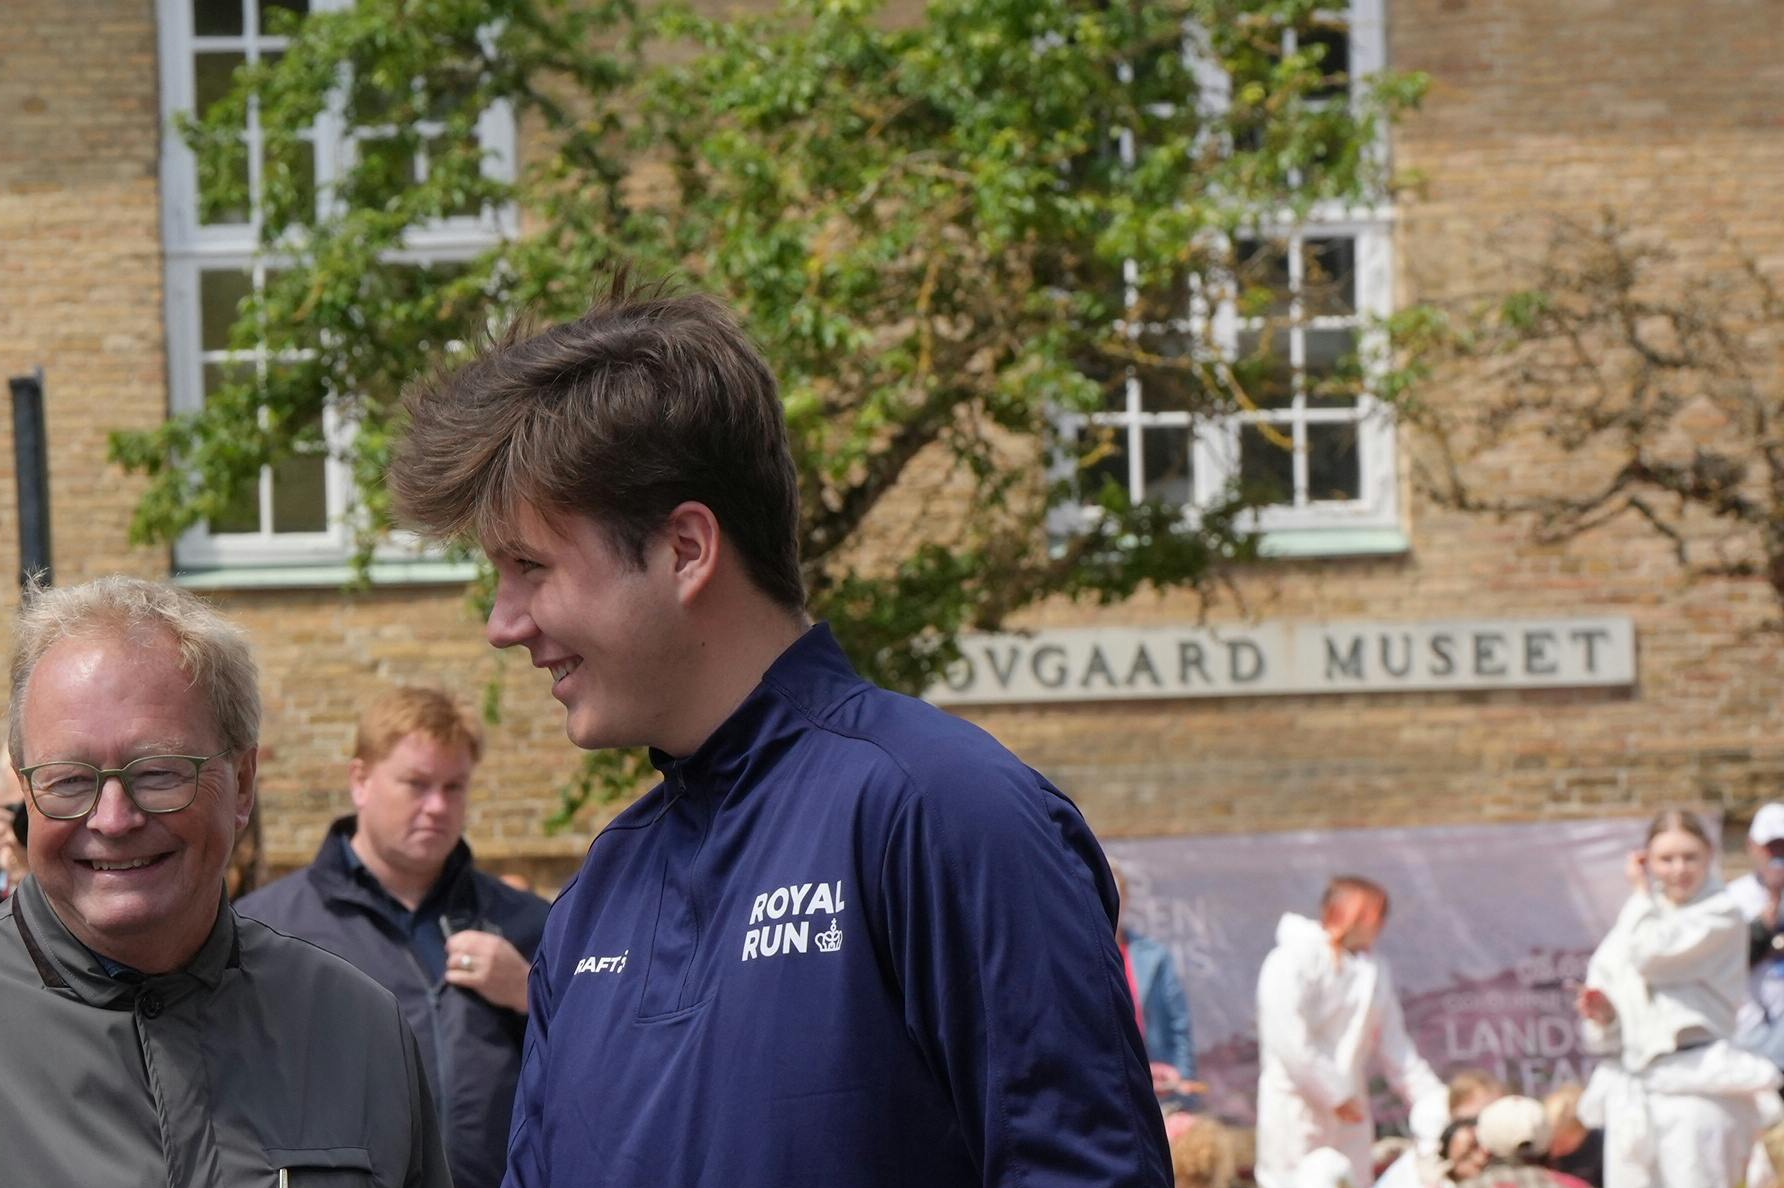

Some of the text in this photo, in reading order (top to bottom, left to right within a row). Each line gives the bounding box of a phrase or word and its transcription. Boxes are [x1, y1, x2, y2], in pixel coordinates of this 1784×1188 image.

[943, 626, 1611, 692] OVGAARD MUSEET
[749, 880, 845, 926] ROYAL
[741, 921, 810, 962] RUN
[1444, 1014, 1576, 1061] LAND
